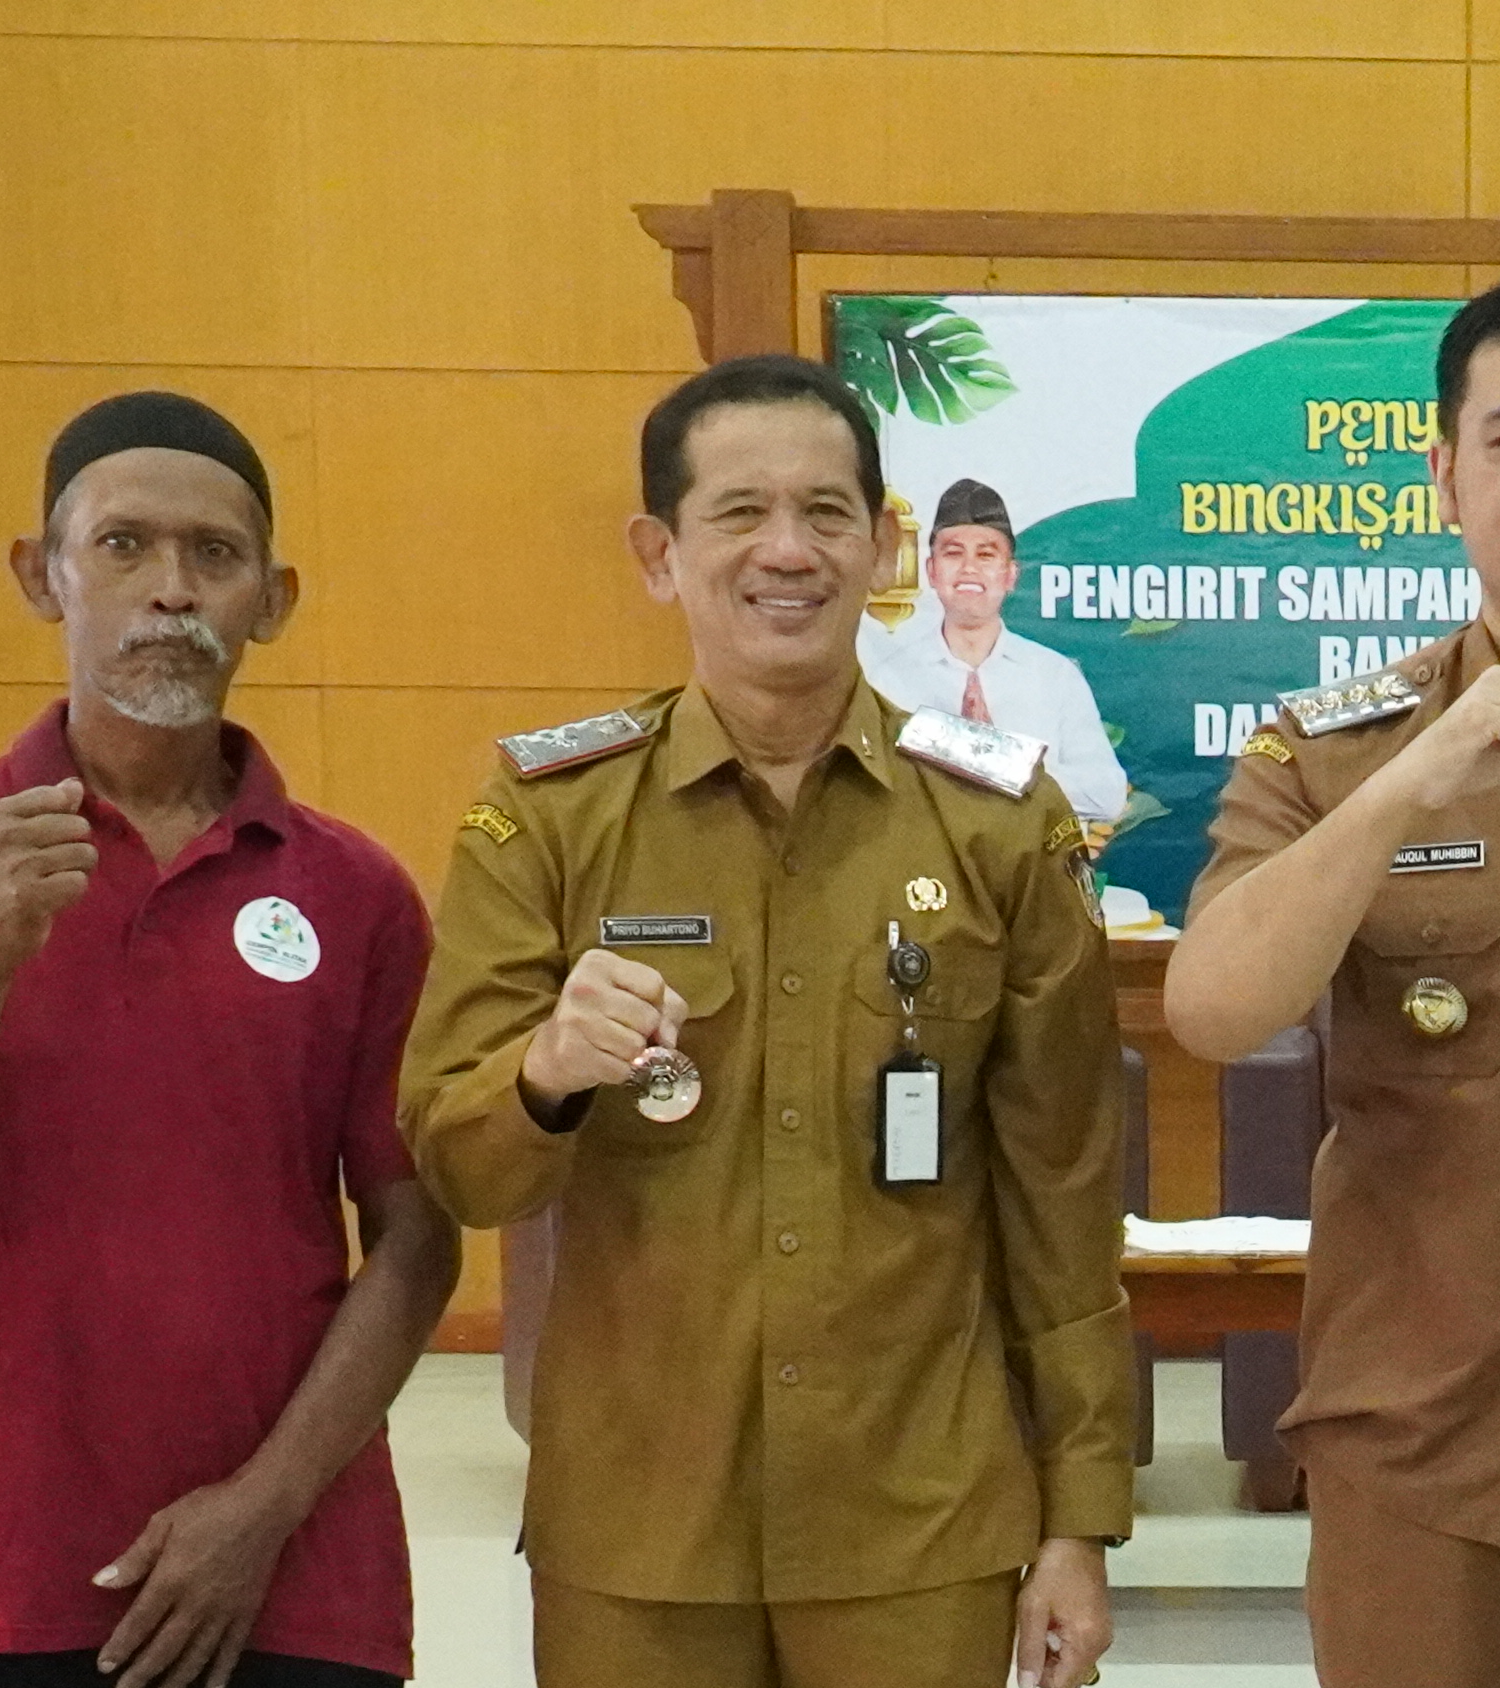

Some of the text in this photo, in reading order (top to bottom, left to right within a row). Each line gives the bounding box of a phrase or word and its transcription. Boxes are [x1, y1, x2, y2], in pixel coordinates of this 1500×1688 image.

[1305, 400, 1439, 466] PENY
[1040, 566, 1266, 620] PENGIRIT
[1278, 565, 1482, 622] SAMPAH
[1395, 847, 1477, 863] AUQUL MUHIBBIN
[612, 924, 640, 936] PRIYO
